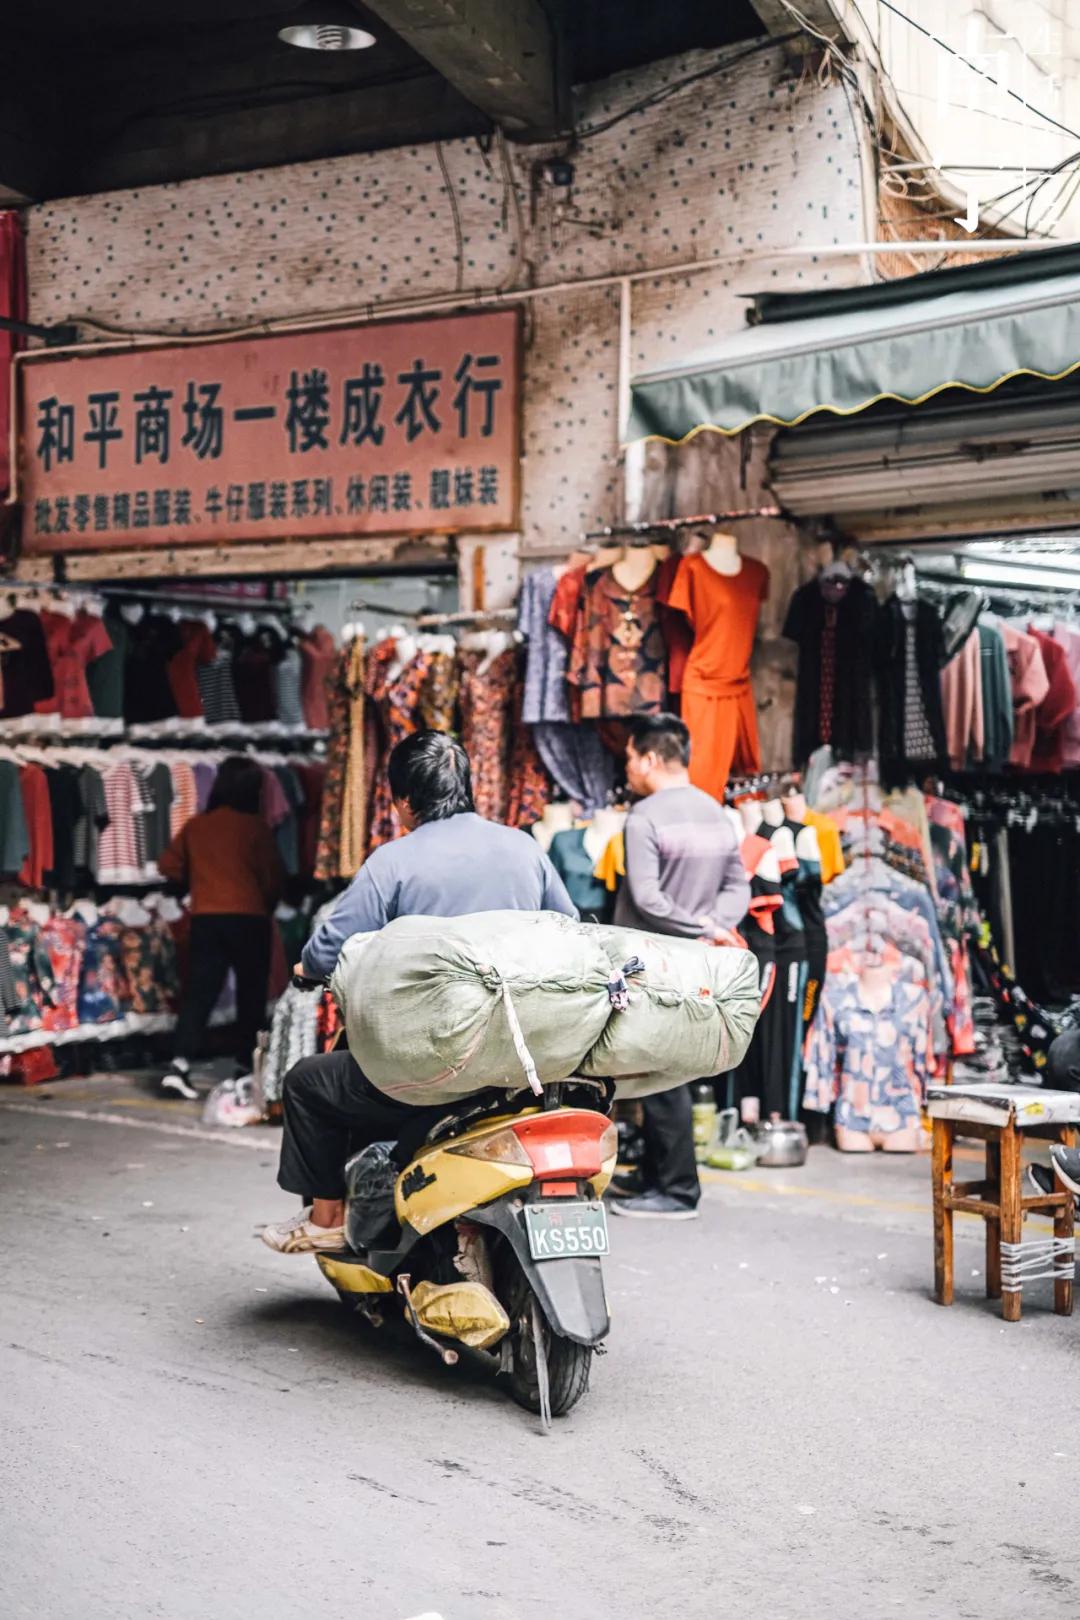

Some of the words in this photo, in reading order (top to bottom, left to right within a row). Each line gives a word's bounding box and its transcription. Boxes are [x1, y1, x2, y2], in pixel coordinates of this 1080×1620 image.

[36, 354, 504, 472] 和平商场一楼成衣行
[534, 1226, 606, 1254] KS550
